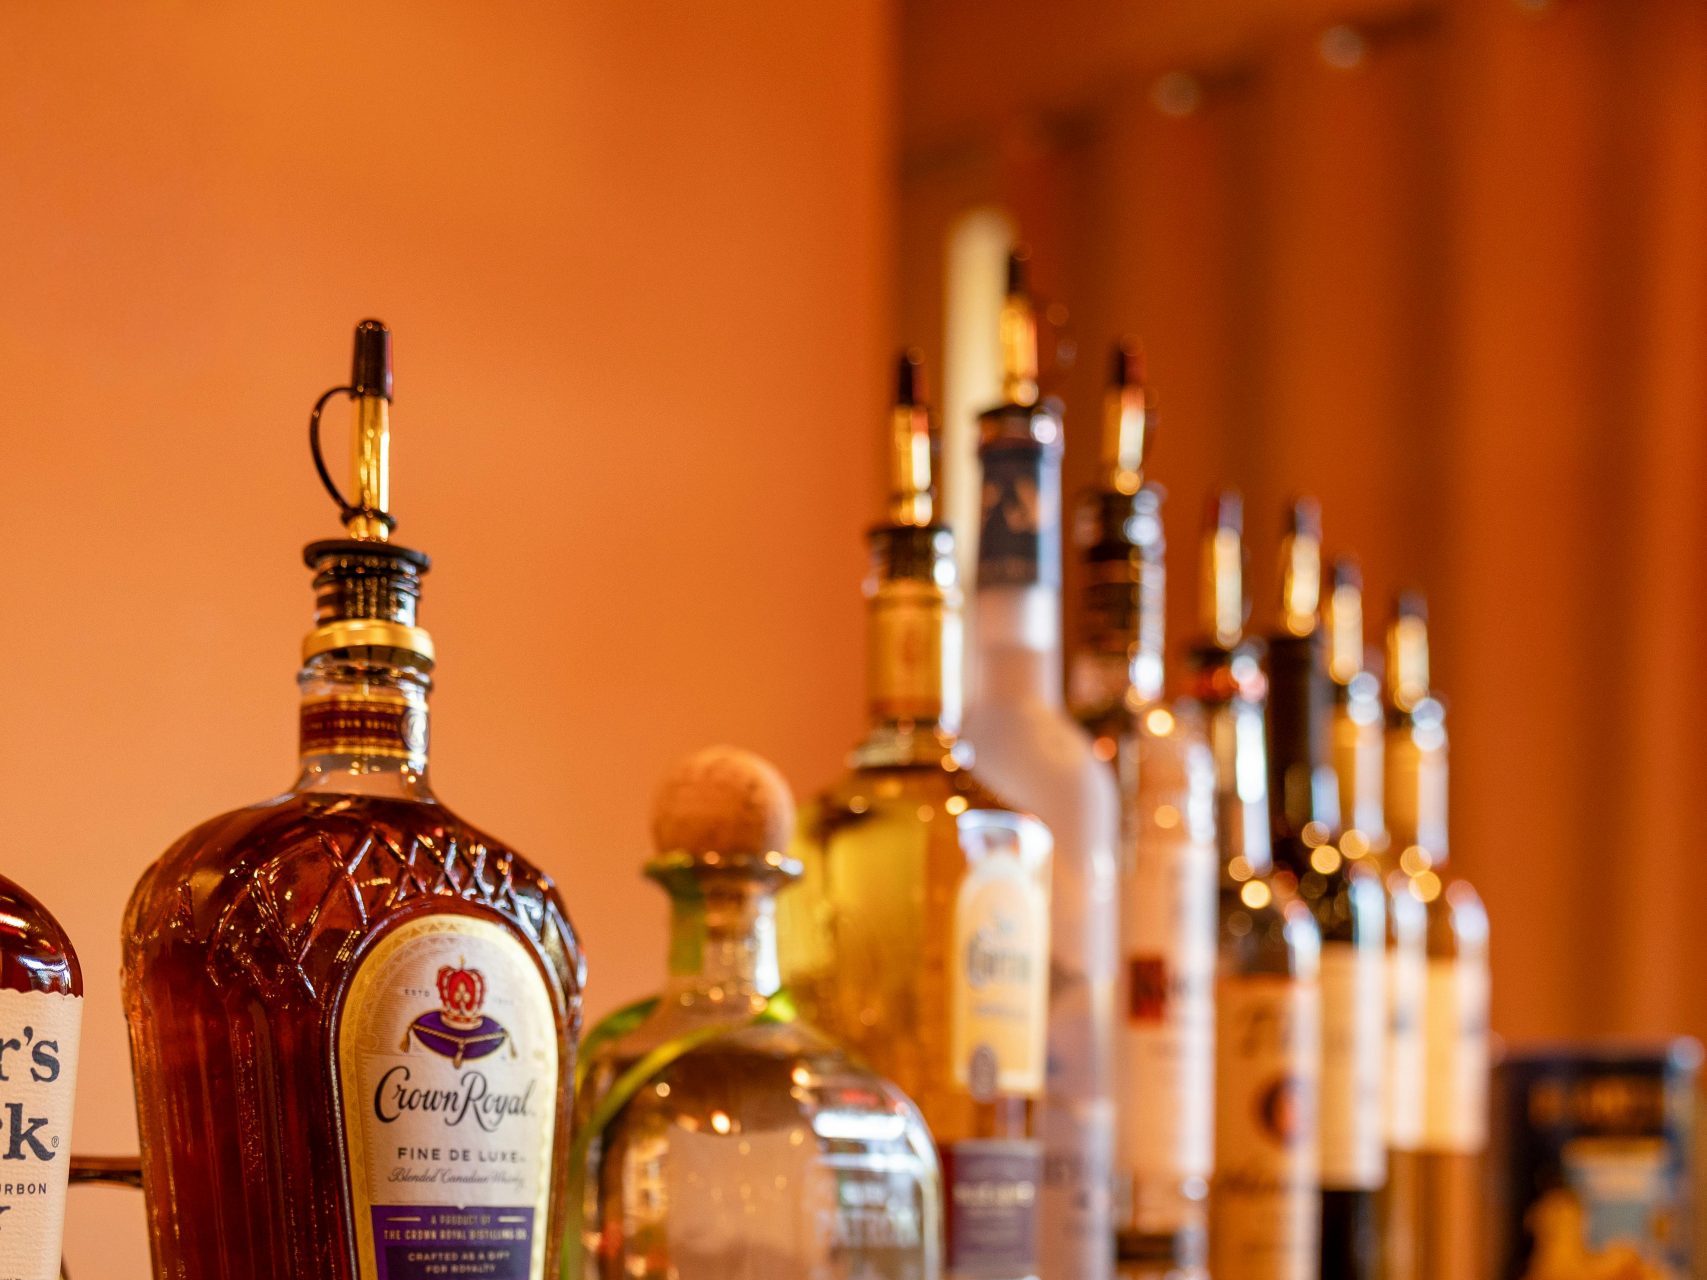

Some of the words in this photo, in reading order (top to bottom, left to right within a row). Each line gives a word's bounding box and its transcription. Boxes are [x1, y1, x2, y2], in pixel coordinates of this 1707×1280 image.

[374, 1065, 458, 1123] Crown
[445, 1070, 536, 1133] Royal
[398, 1147, 441, 1161] FINE
[451, 1149, 471, 1162] DE
[388, 1166, 437, 1183] Blended
[0, 1183, 47, 1195] RBON
